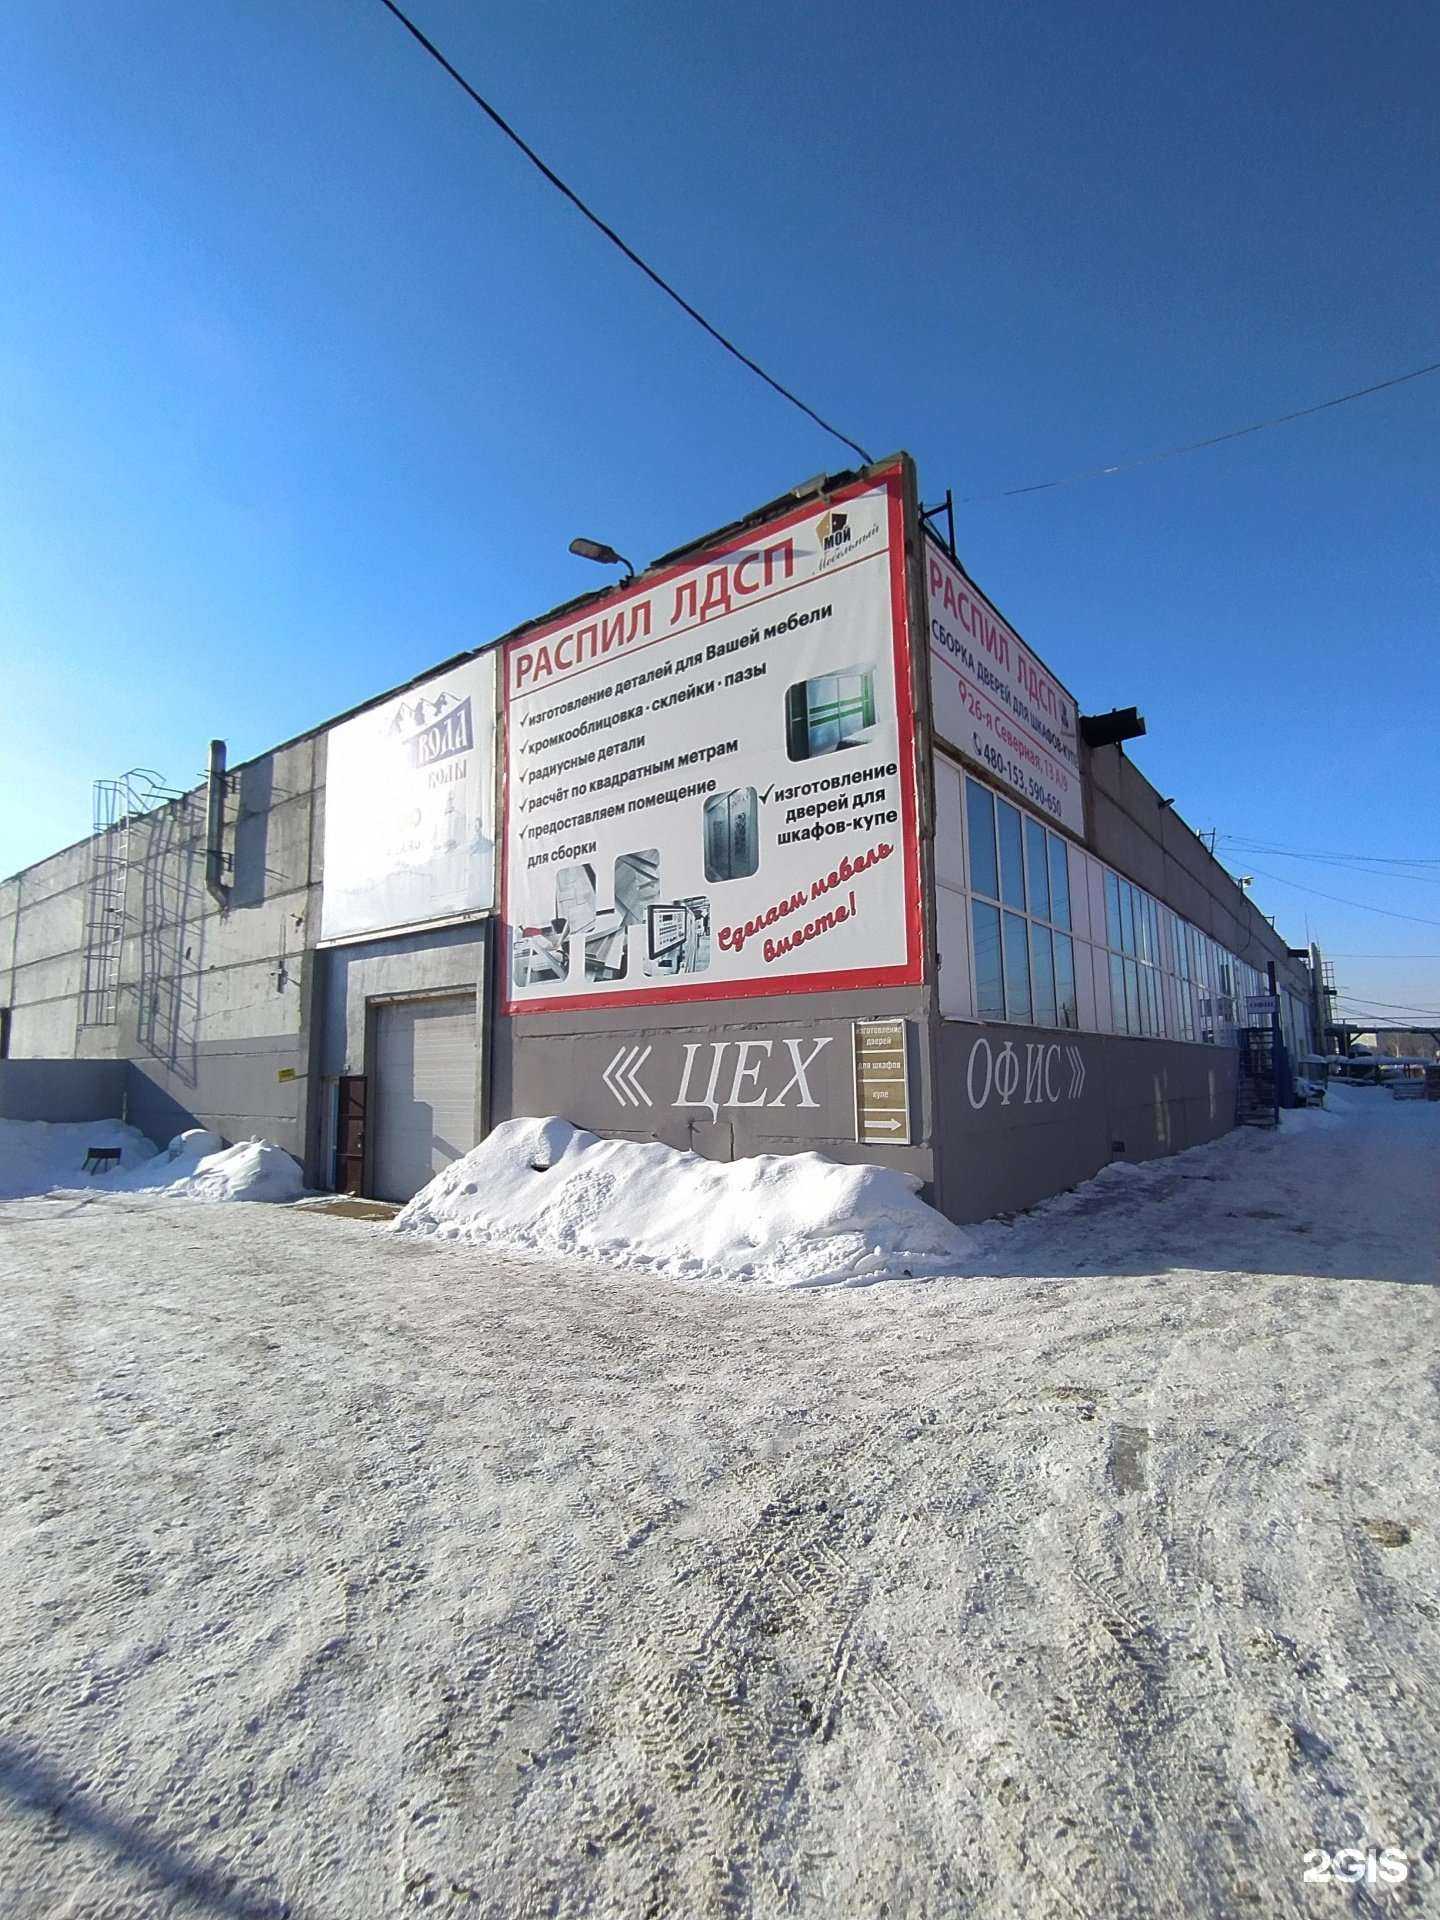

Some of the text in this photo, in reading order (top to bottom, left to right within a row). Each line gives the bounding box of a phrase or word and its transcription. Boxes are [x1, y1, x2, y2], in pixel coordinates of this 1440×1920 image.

[824, 525, 851, 550] МОЙ
[516, 538, 793, 688] РАСПИЛ ЛДСП
[929, 558, 1057, 720] РАСПИЛ ЛДСП
[528, 604, 833, 726] изготовление деталей для Вашей мебели
[932, 619, 975, 674] СБОРКА
[977, 661, 1011, 706] ДВЕРЕЙ
[528, 663, 767, 754] кромкооблицовка склейки пазы
[968, 695, 993, 730] 26-я
[995, 717, 1043, 772] Северная,
[528, 735, 646, 784] радиусные детали
[528, 738, 739, 813] расчёт по квадратным метрам
[774, 763, 898, 803] изготовление
[528, 779, 716, 840] предоставляем помещение
[778, 810, 898, 845] шкафов-купе
[786, 788, 886, 824] дверей для
[528, 841, 597, 869] для сборки
[718, 842, 894, 952] Сделаем мебель
[671, 1037, 834, 1125] ЦЕХ
[967, 1038, 1061, 1109] ОФИС
